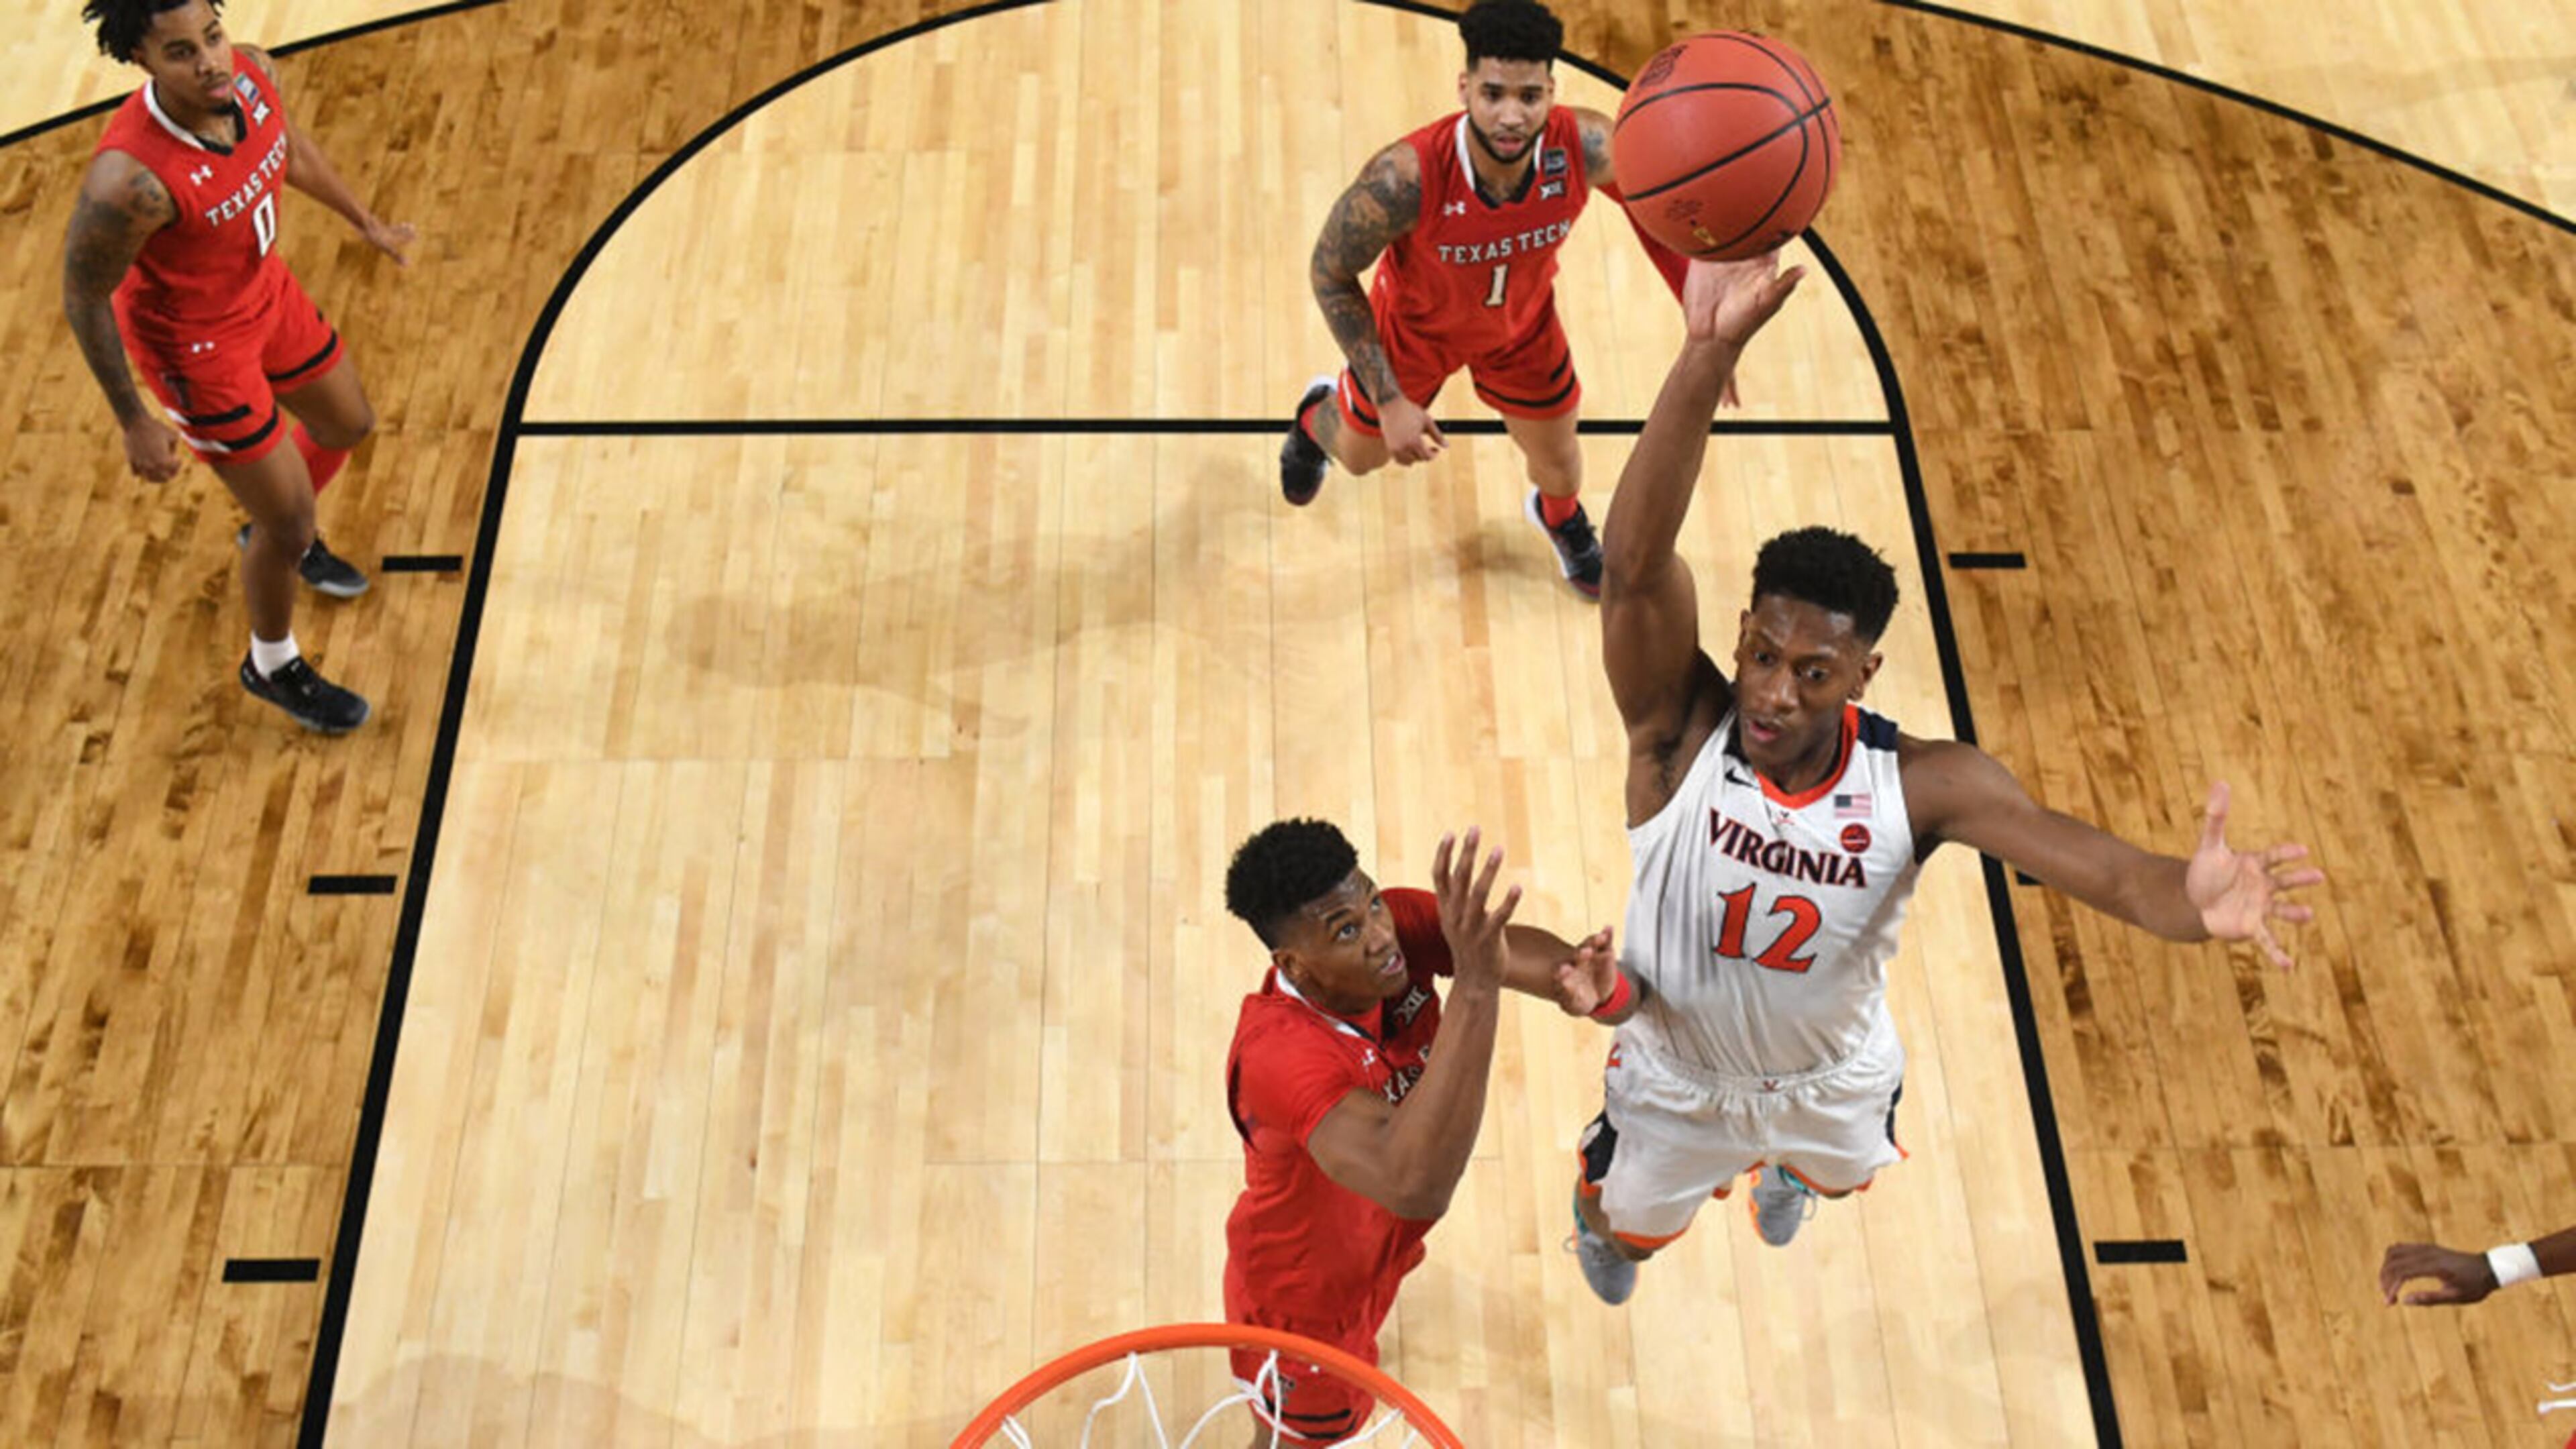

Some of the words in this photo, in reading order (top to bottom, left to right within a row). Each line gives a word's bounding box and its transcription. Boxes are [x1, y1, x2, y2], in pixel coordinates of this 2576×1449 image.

[205, 172, 263, 226] TEXAS
[253, 191, 276, 258] 0
[1438, 238, 1511, 262] TEXAS
[1484, 264, 1507, 307] 1
[1710, 807, 1866, 888] VIRGINIA
[1711, 881, 1822, 973] 12
[1384, 1065, 1421, 1102] XAS
